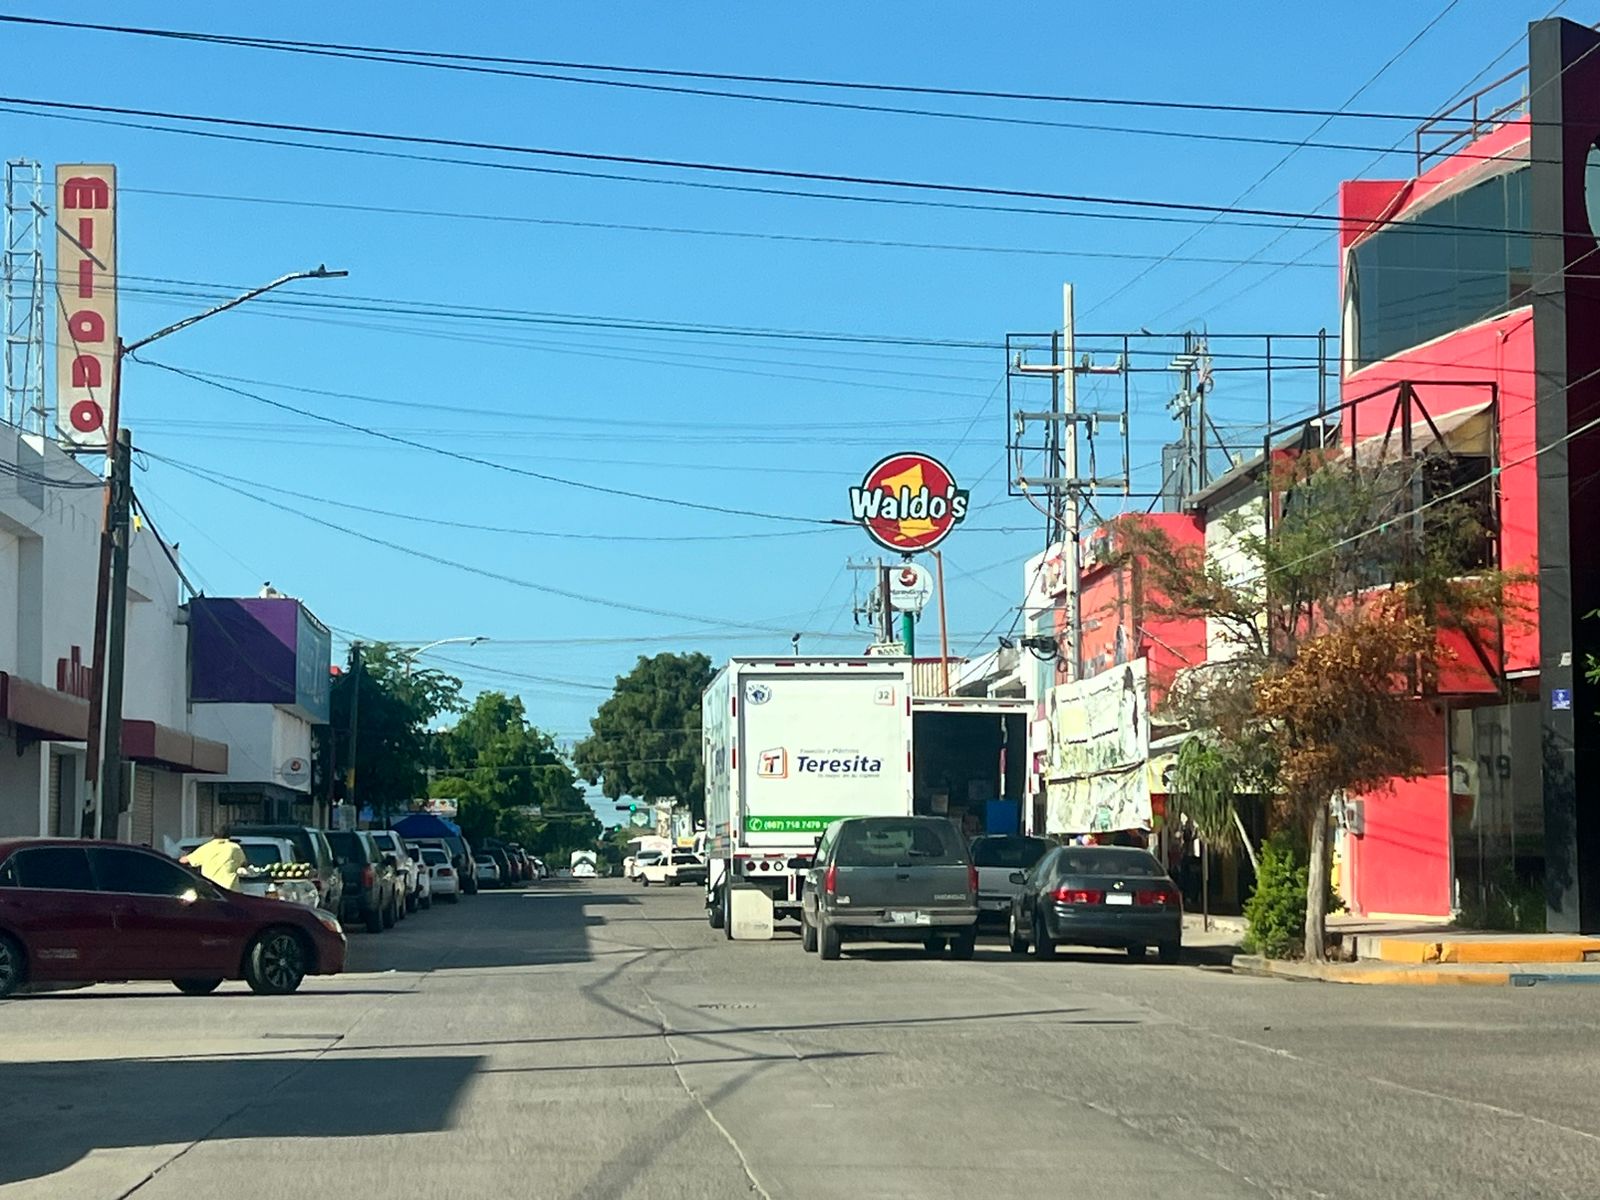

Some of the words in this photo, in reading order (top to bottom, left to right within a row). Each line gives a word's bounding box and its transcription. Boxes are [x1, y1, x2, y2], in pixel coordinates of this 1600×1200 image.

[63, 177, 109, 433] milano
[851, 485, 968, 520] Waldo's
[797, 755, 882, 772] Teresita
